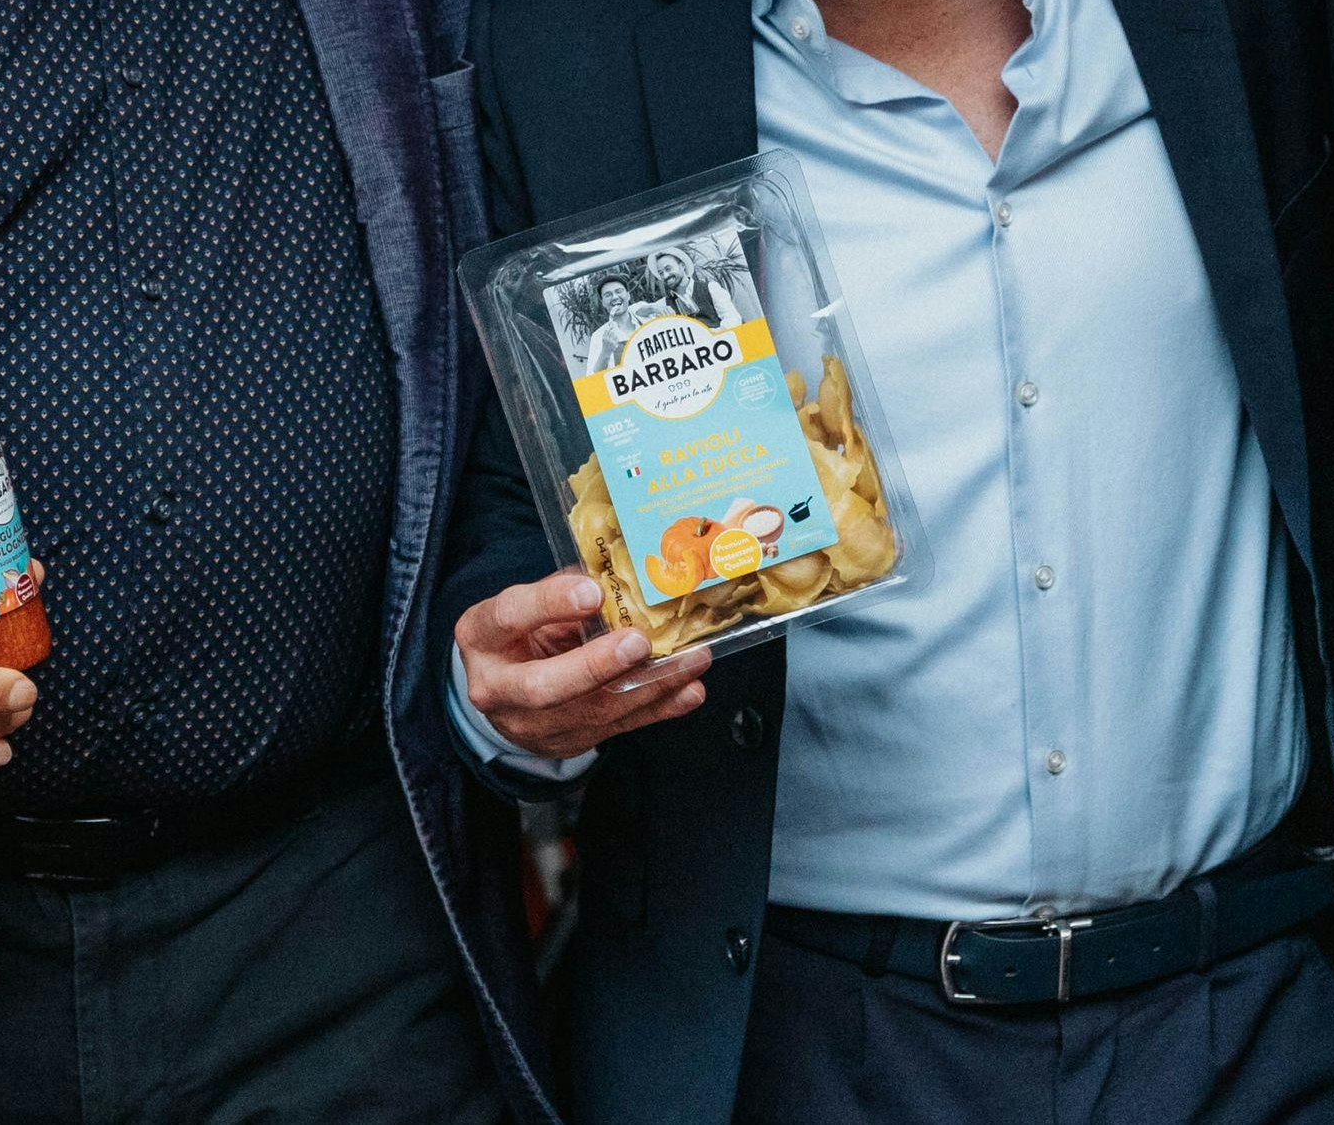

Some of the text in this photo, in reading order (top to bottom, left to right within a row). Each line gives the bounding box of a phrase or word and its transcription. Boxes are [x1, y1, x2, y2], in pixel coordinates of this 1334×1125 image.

[637, 326, 695, 362] FRATELLI
[612, 339, 733, 397] BARBARO
[602, 421, 623, 436] 100
[659, 427, 741, 467] RAVIOLI
[647, 467, 697, 496] ALLA
[700, 443, 769, 477] ZUCCA
